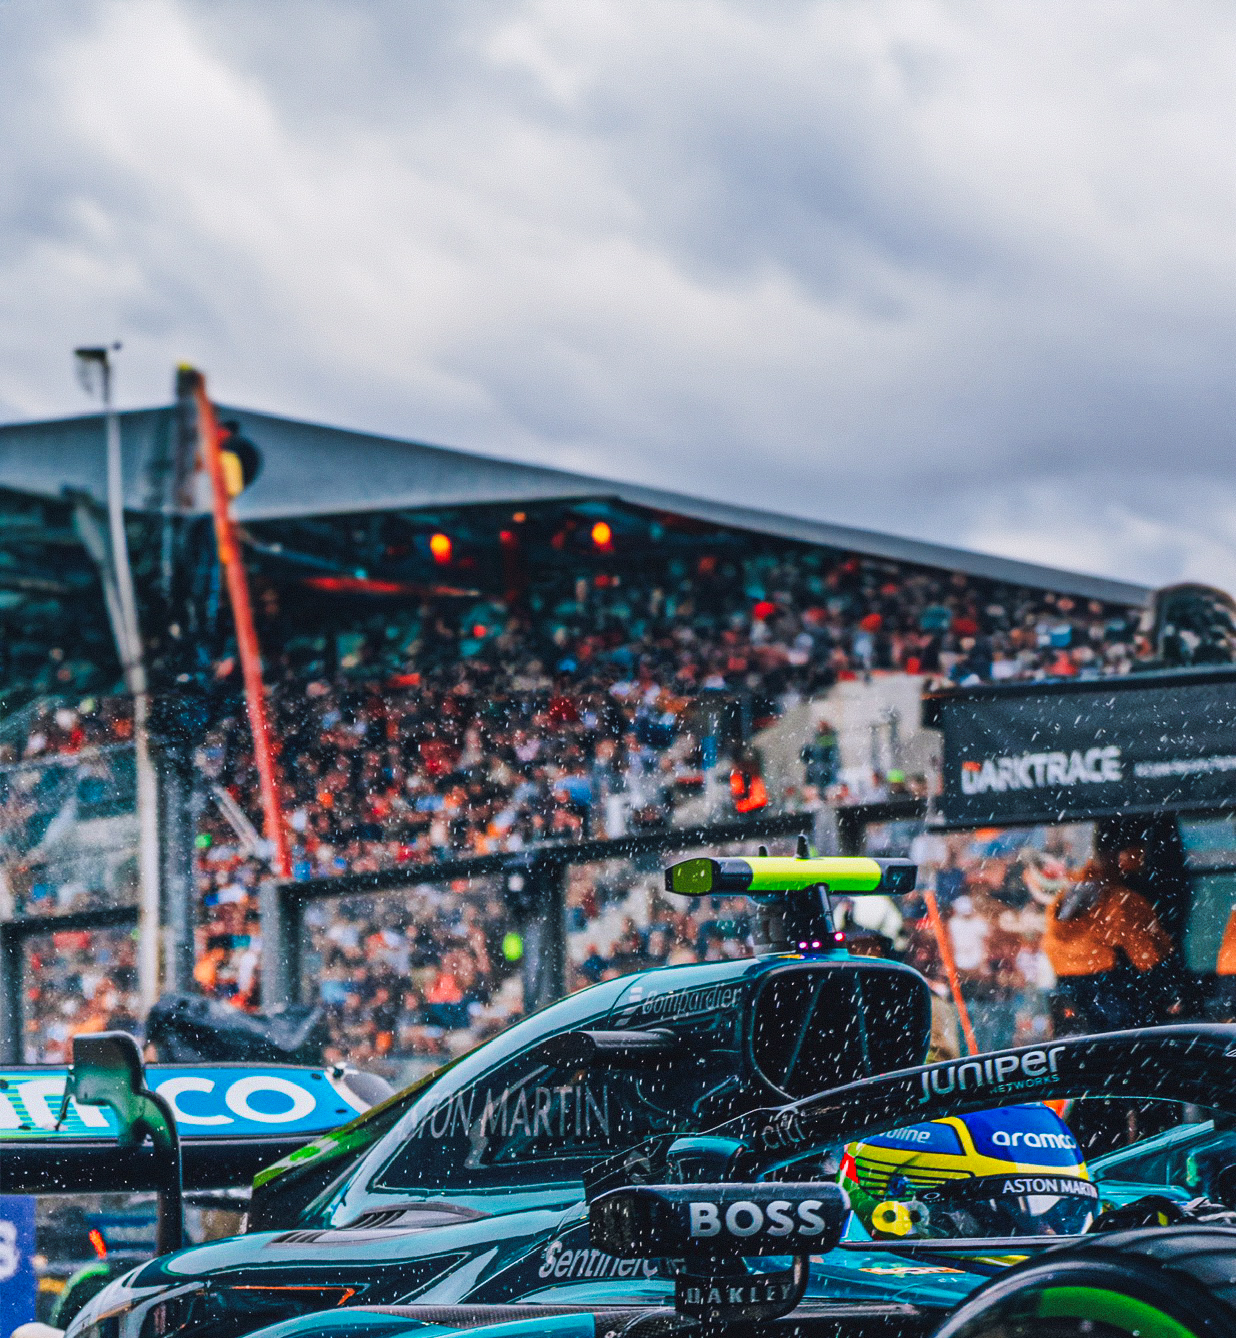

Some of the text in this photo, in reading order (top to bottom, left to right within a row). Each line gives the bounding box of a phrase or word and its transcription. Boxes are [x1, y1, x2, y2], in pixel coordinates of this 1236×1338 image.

[961, 745, 1122, 795] DARKTRACE
[642, 988, 742, 1015] Bombardier
[478, 1085, 609, 1138] MARTIN
[880, 1126, 931, 1144] oline
[1002, 1178, 1059, 1194] ASTON
[689, 1200, 826, 1238] BOSS
[686, 1283, 792, 1305] OAKLEY
